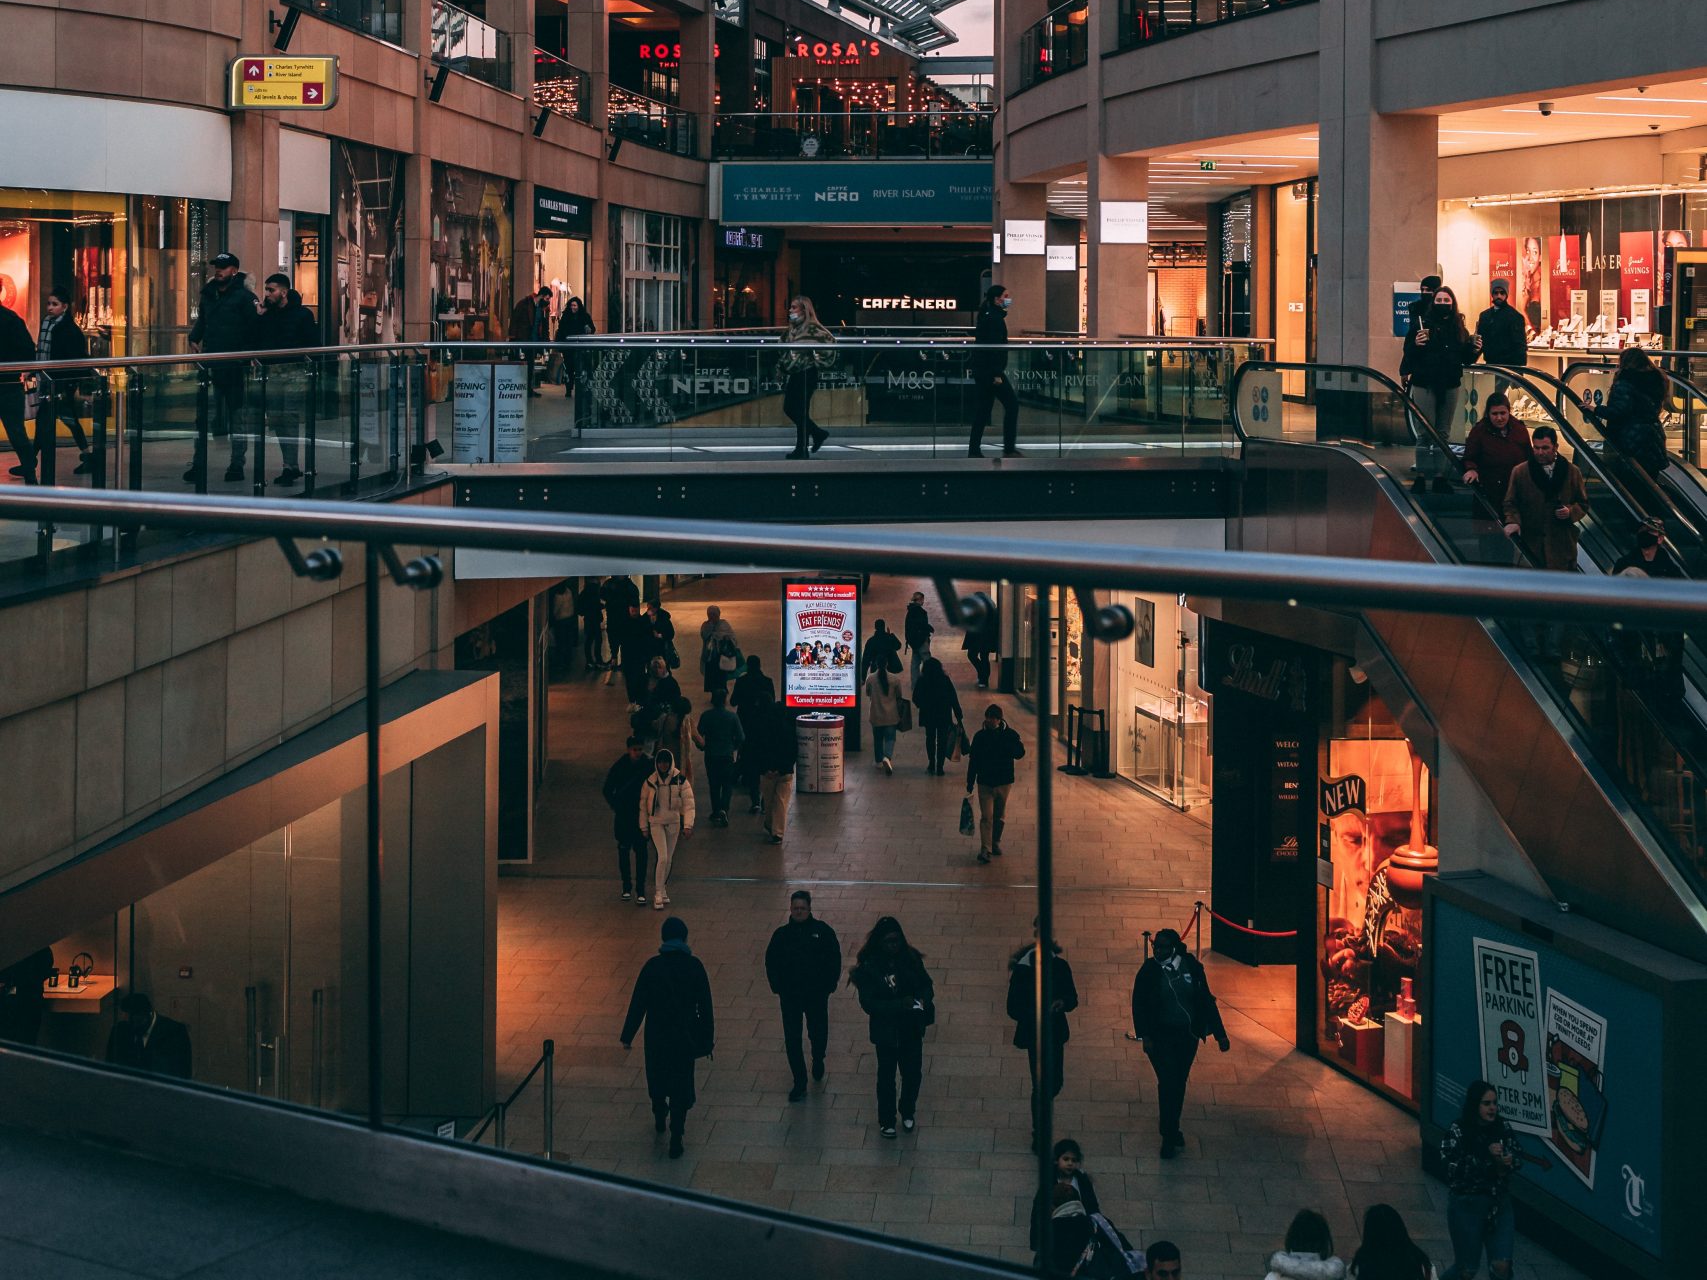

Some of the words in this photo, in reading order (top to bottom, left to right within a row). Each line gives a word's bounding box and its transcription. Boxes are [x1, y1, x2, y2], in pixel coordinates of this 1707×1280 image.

[797, 39, 880, 57] ROSA'S
[733, 193, 801, 201] TYRWHITT
[814, 191, 859, 202] NERO
[872, 189, 899, 198] RIVER
[902, 189, 935, 198] ISLAND
[539, 198, 559, 211] CHARLES
[1581, 254, 1621, 270] FASER
[1628, 256, 1644, 267] Great
[1492, 269, 1514, 277] SAVINGS
[1624, 266, 1650, 275] SAVINGS
[862, 295, 911, 309] CAFFÈ
[913, 299, 957, 310] NERO
[888, 370, 935, 390] M&S
[1013, 369, 1058, 380] STONER
[1065, 375, 1099, 387] RIVER
[672, 378, 750, 394] NERO
[761, 382, 861, 391] TYHITT
[498, 391, 523, 400] hours
[801, 616, 814, 627] FAT
[813, 615, 841, 628] FRIENDS
[1325, 778, 1360, 815] NEW
[1482, 953, 1534, 999] FREE
[1485, 992, 1535, 1019] PARKING
[1552, 1003, 1567, 1018] WHEN
[1568, 1012, 1579, 1025] YOU
[1579, 1020, 1598, 1037] SPEND
[1555, 1022, 1575, 1040] TRINITY
[1575, 1036, 1591, 1051] LEEDS
[1563, 1019, 1571, 1029] OR
[1571, 1024, 1586, 1038] MORE
[1586, 1034, 1594, 1043] AT
[1497, 1085, 1520, 1104] FTER
[1522, 1091, 1542, 1110] 5PM
[1497, 1104, 1518, 1116] ONDAY
